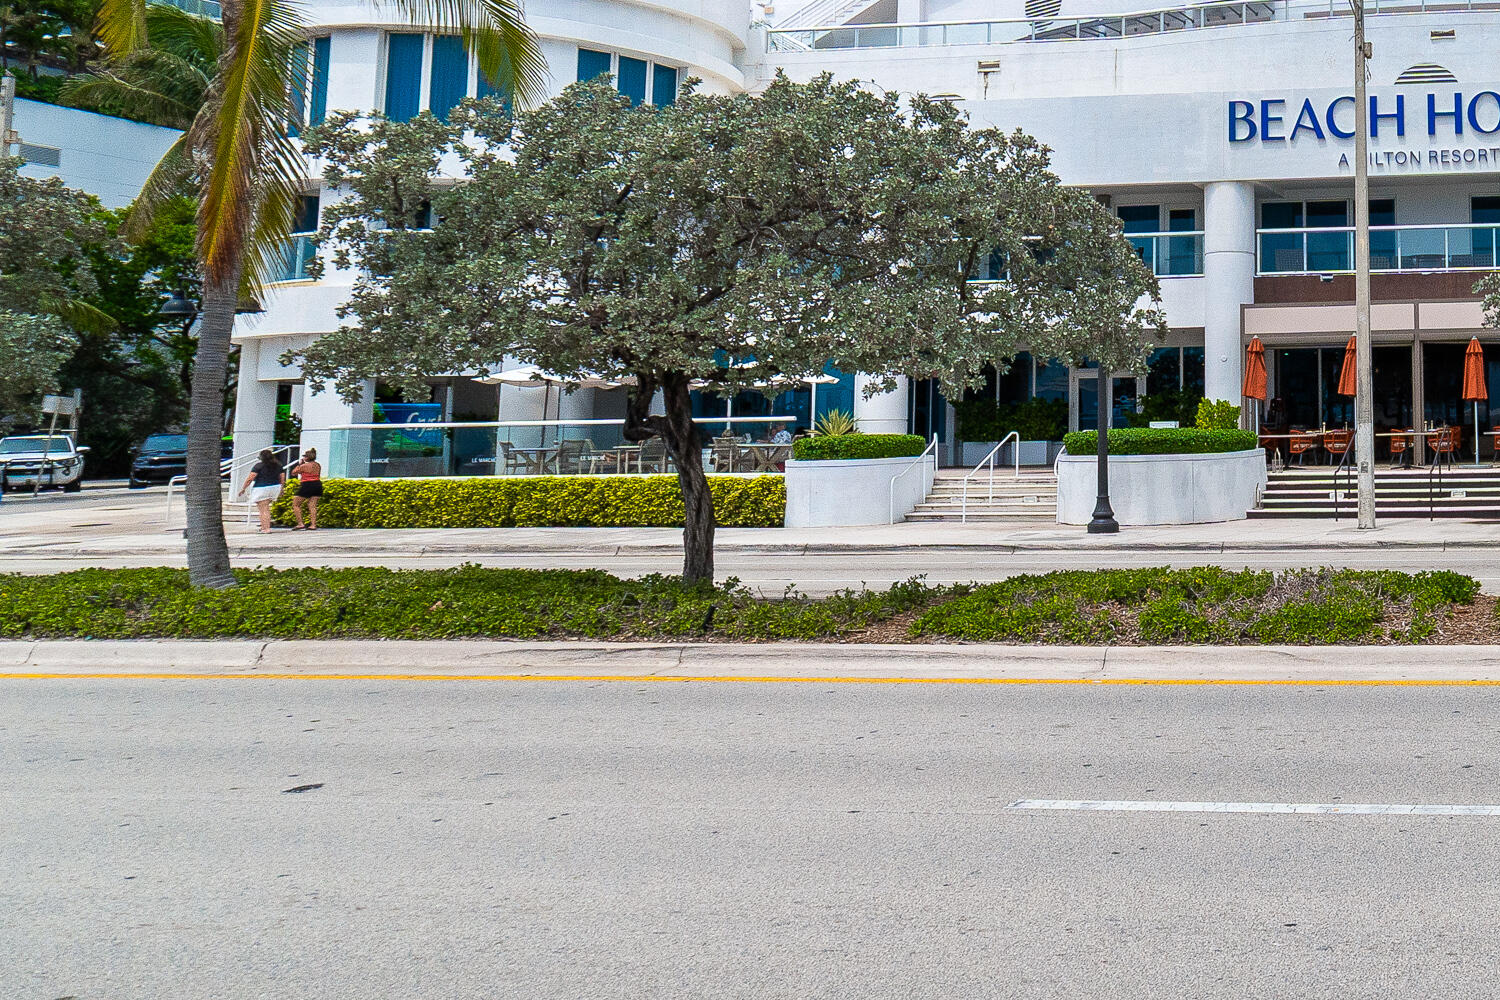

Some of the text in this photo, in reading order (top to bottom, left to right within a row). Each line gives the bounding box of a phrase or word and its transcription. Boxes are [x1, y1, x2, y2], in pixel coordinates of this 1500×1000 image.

[1228, 94, 1405, 143] BEACH
[1338, 147, 1500, 167] A ILTON RESORT
